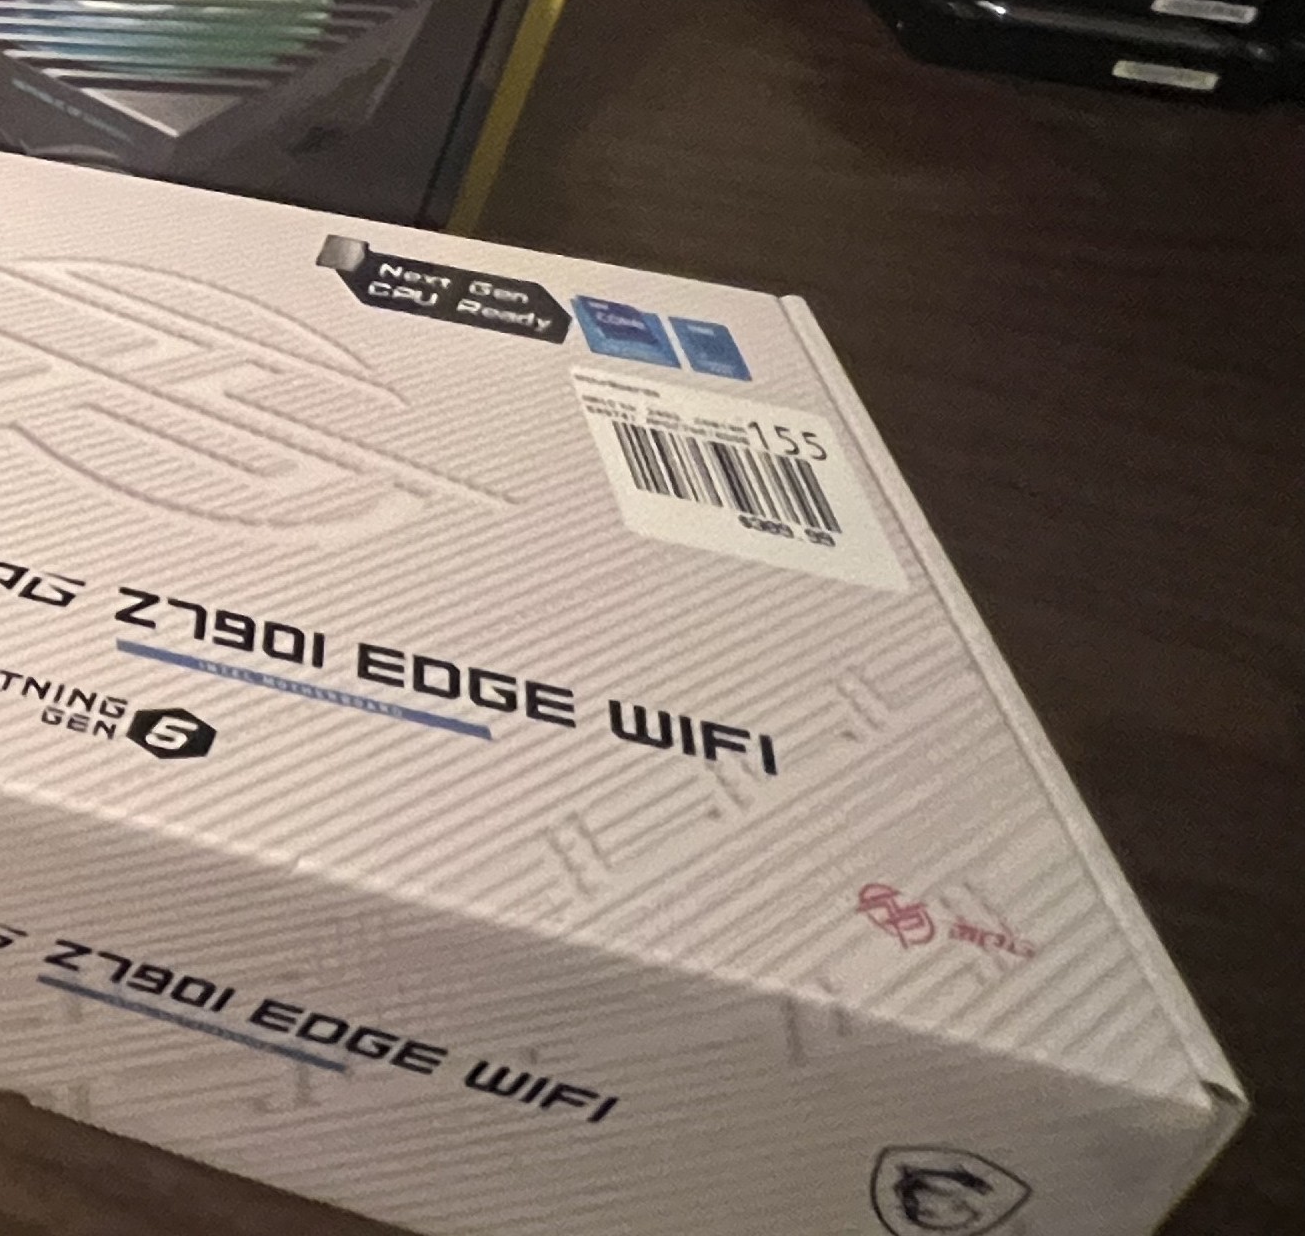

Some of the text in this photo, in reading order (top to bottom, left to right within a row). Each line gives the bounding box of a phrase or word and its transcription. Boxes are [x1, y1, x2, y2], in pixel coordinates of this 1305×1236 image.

[367, 280, 555, 334] CPU Ready
[378, 261, 530, 306] Next Gen
[748, 420, 828, 462] 155
[115, 586, 326, 670] Z790I
[356, 641, 579, 731] EDGE
[607, 699, 781, 778] WIFI
[39, 705, 118, 740] GEN
[43, 939, 236, 1015] Z790I
[248, 999, 450, 1076] EDGE
[462, 1060, 623, 1127] WIFI
